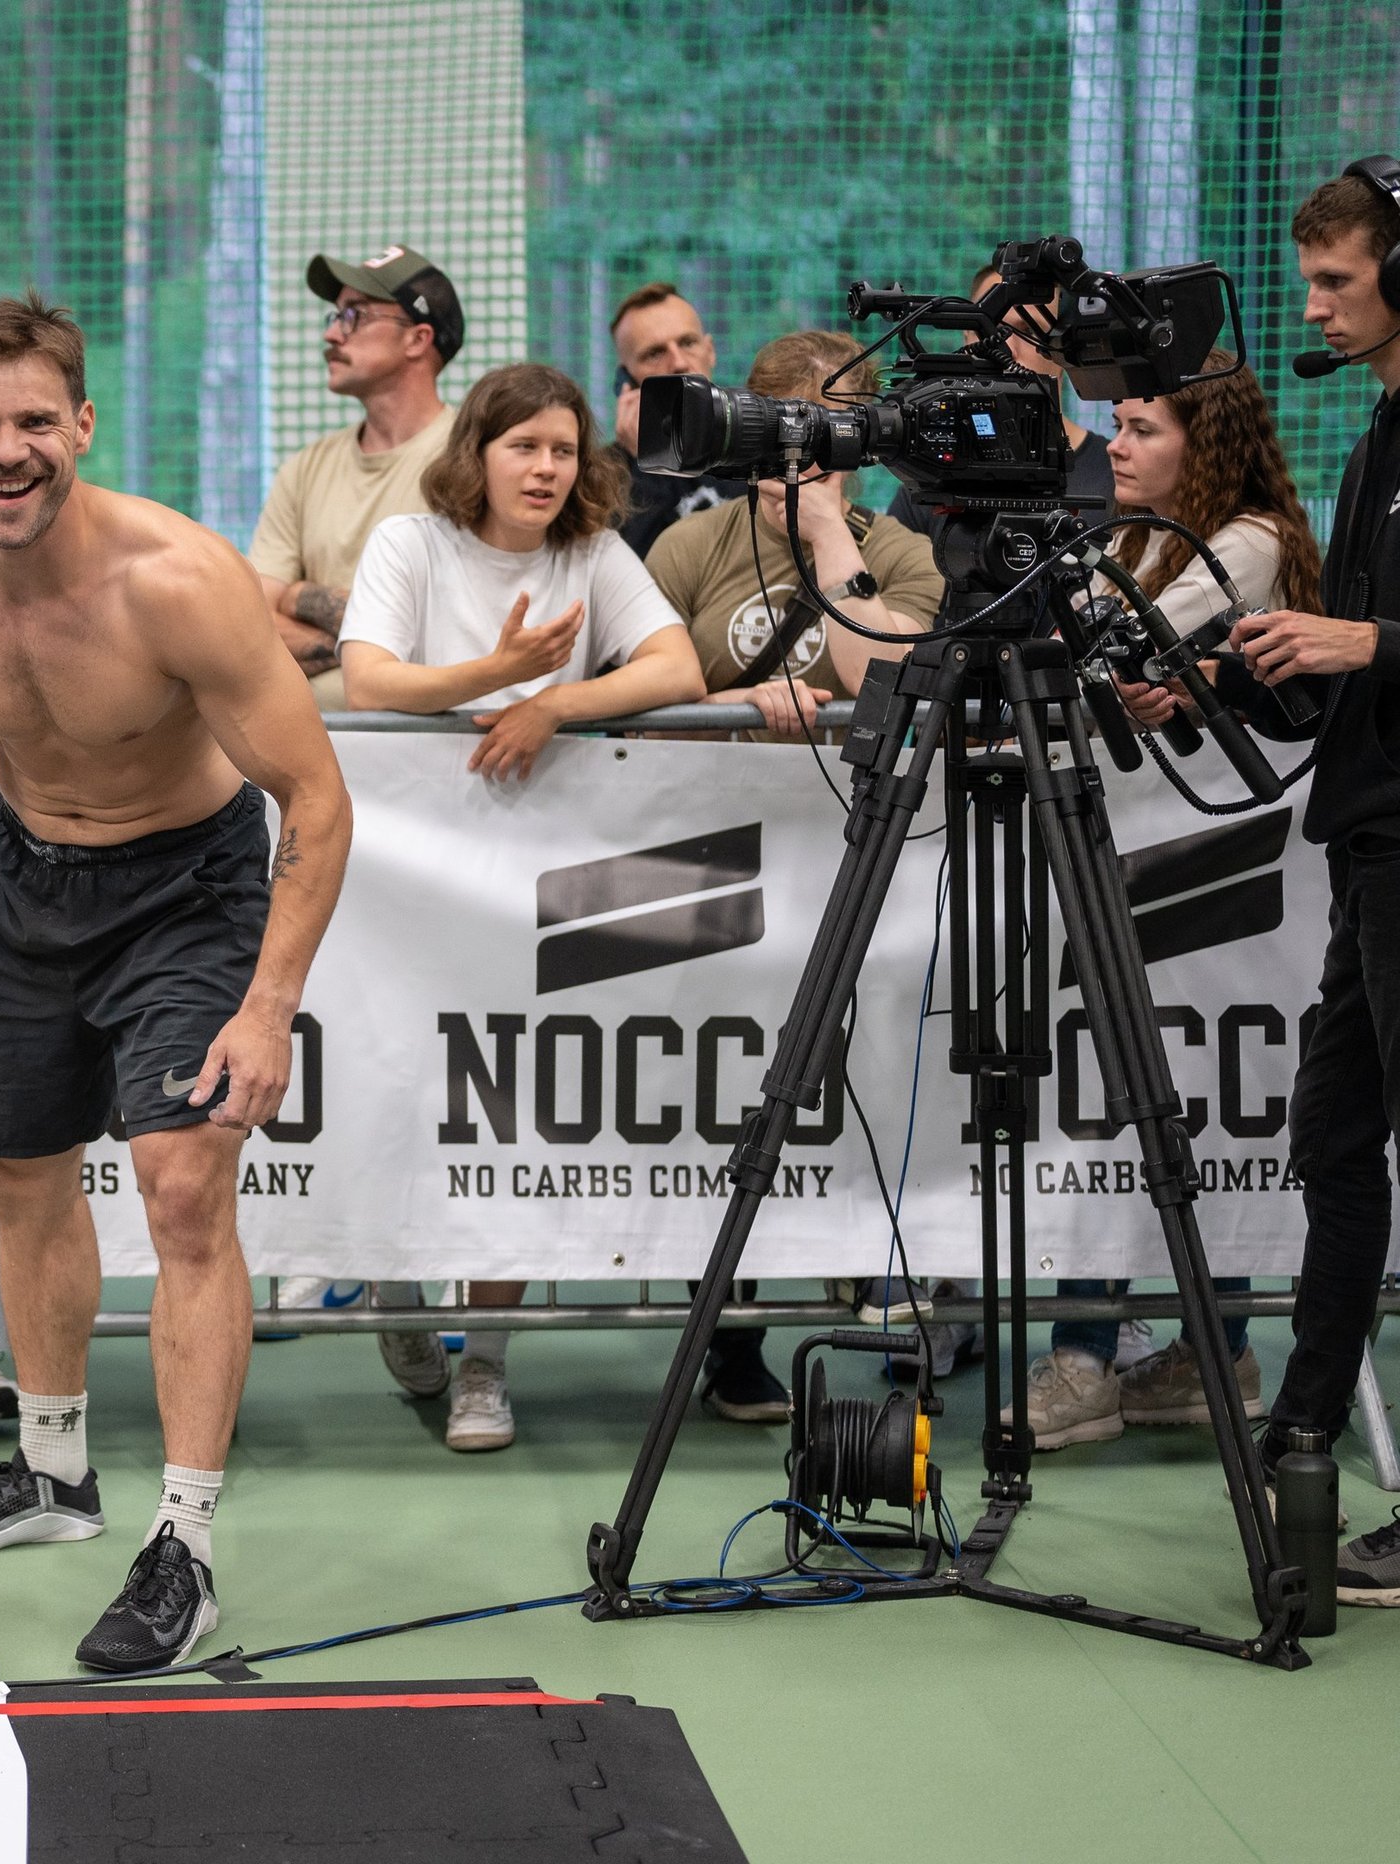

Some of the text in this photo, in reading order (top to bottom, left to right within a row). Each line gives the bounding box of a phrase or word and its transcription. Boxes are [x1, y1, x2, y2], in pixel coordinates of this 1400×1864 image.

[447, 1164, 834, 1198] NO CARBS COMNY
